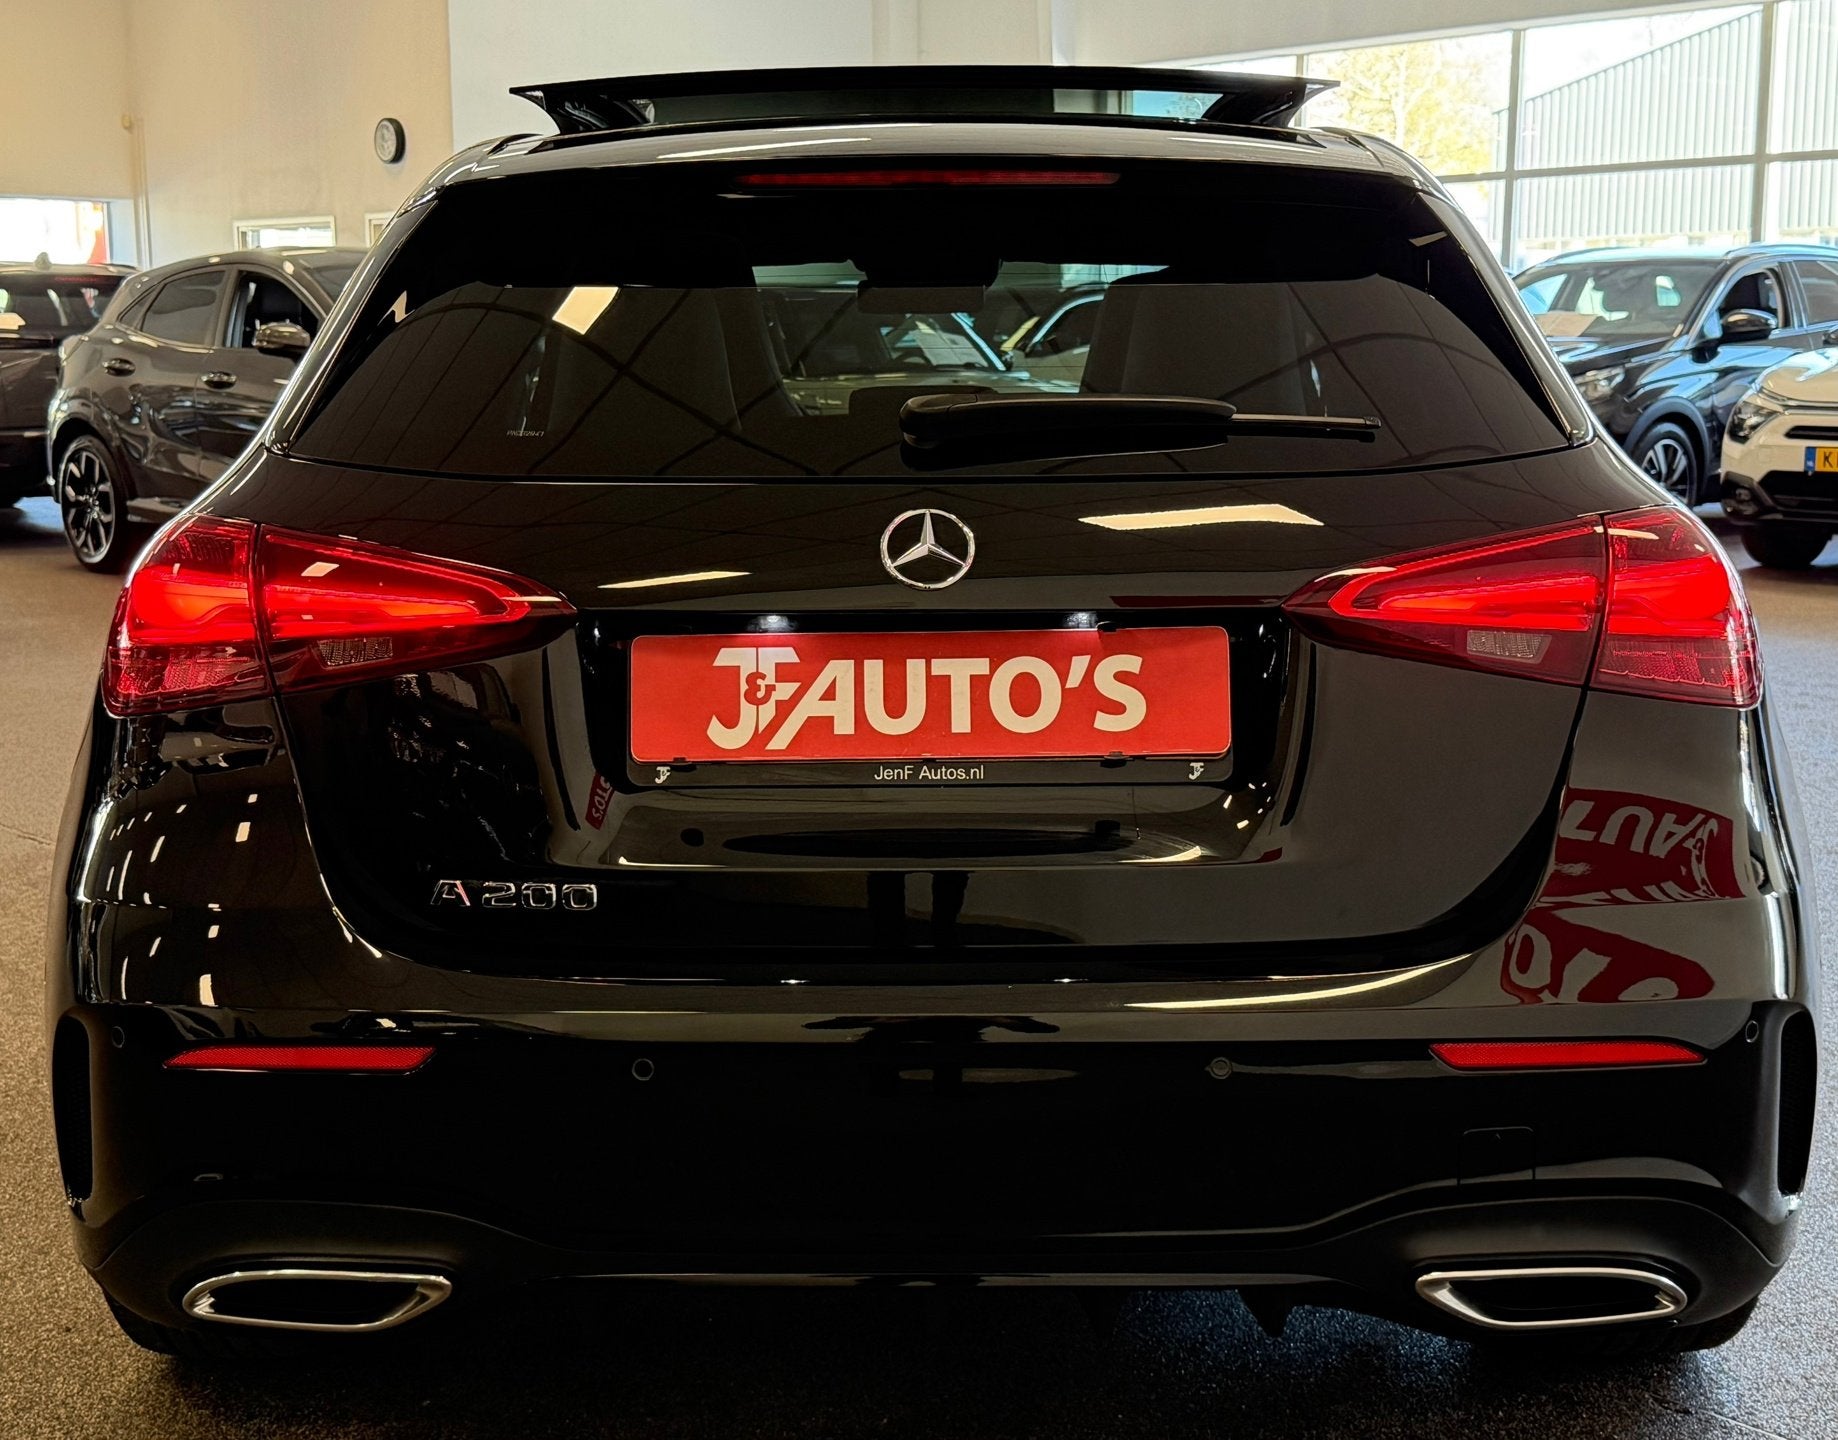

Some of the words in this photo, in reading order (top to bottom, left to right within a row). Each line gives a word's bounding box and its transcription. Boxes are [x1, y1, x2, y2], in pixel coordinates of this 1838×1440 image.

[1823, 450, 1838, 468] K
[764, 654, 1147, 750] AUTO'S
[874, 765, 914, 780] JenF
[918, 764, 985, 780] Autos.nl
[430, 879, 471, 906] A
[482, 881, 598, 911] 200
